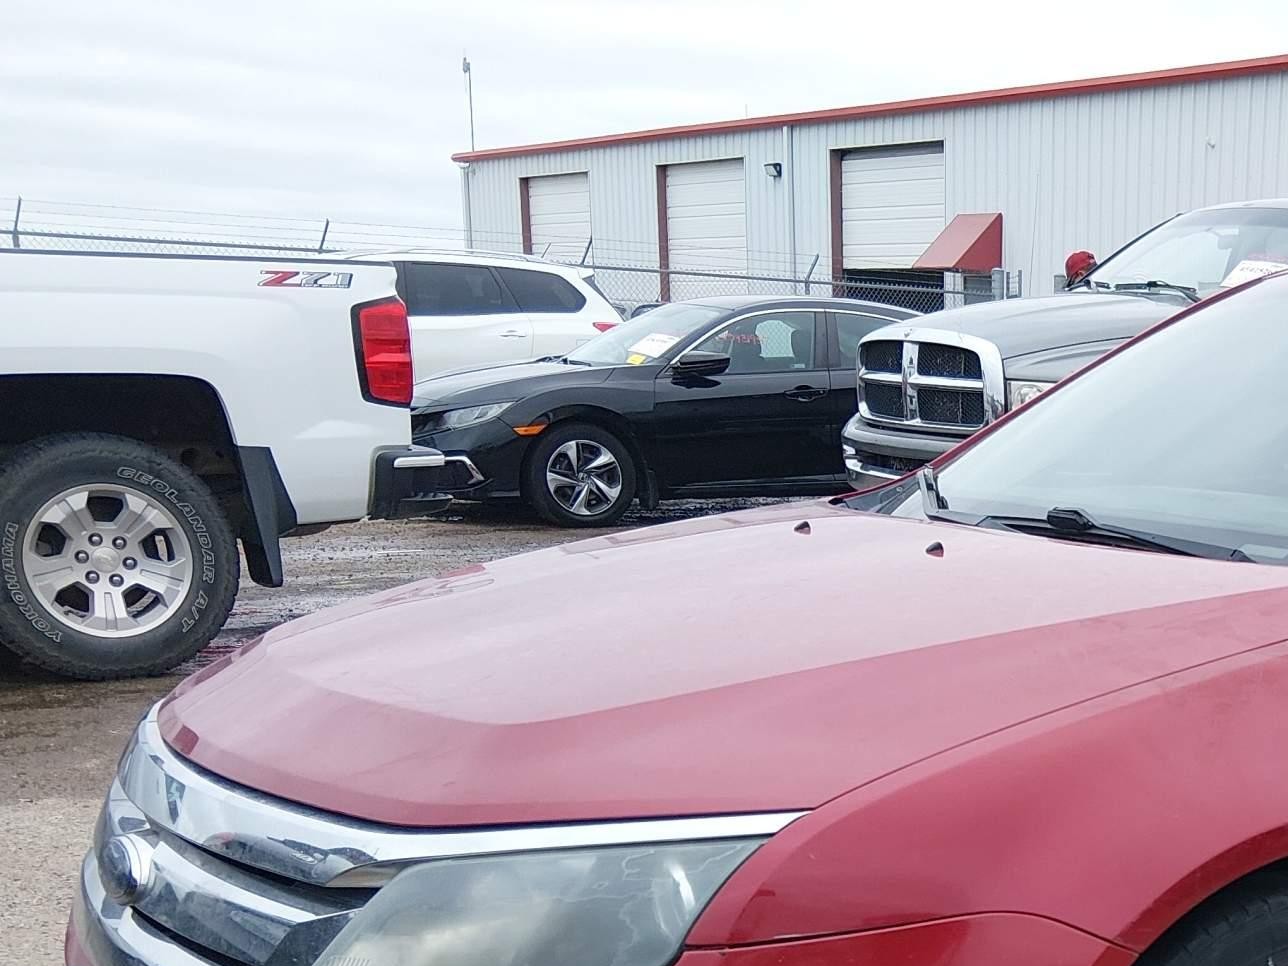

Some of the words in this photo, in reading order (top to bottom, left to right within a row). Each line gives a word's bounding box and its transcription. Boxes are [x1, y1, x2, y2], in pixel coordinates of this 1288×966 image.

[258, 270, 353, 289] Z71
[117, 466, 215, 585] GEOLANDAR
[1, 521, 62, 643] YOKOHAMA
[181, 590, 209, 633] A/T
